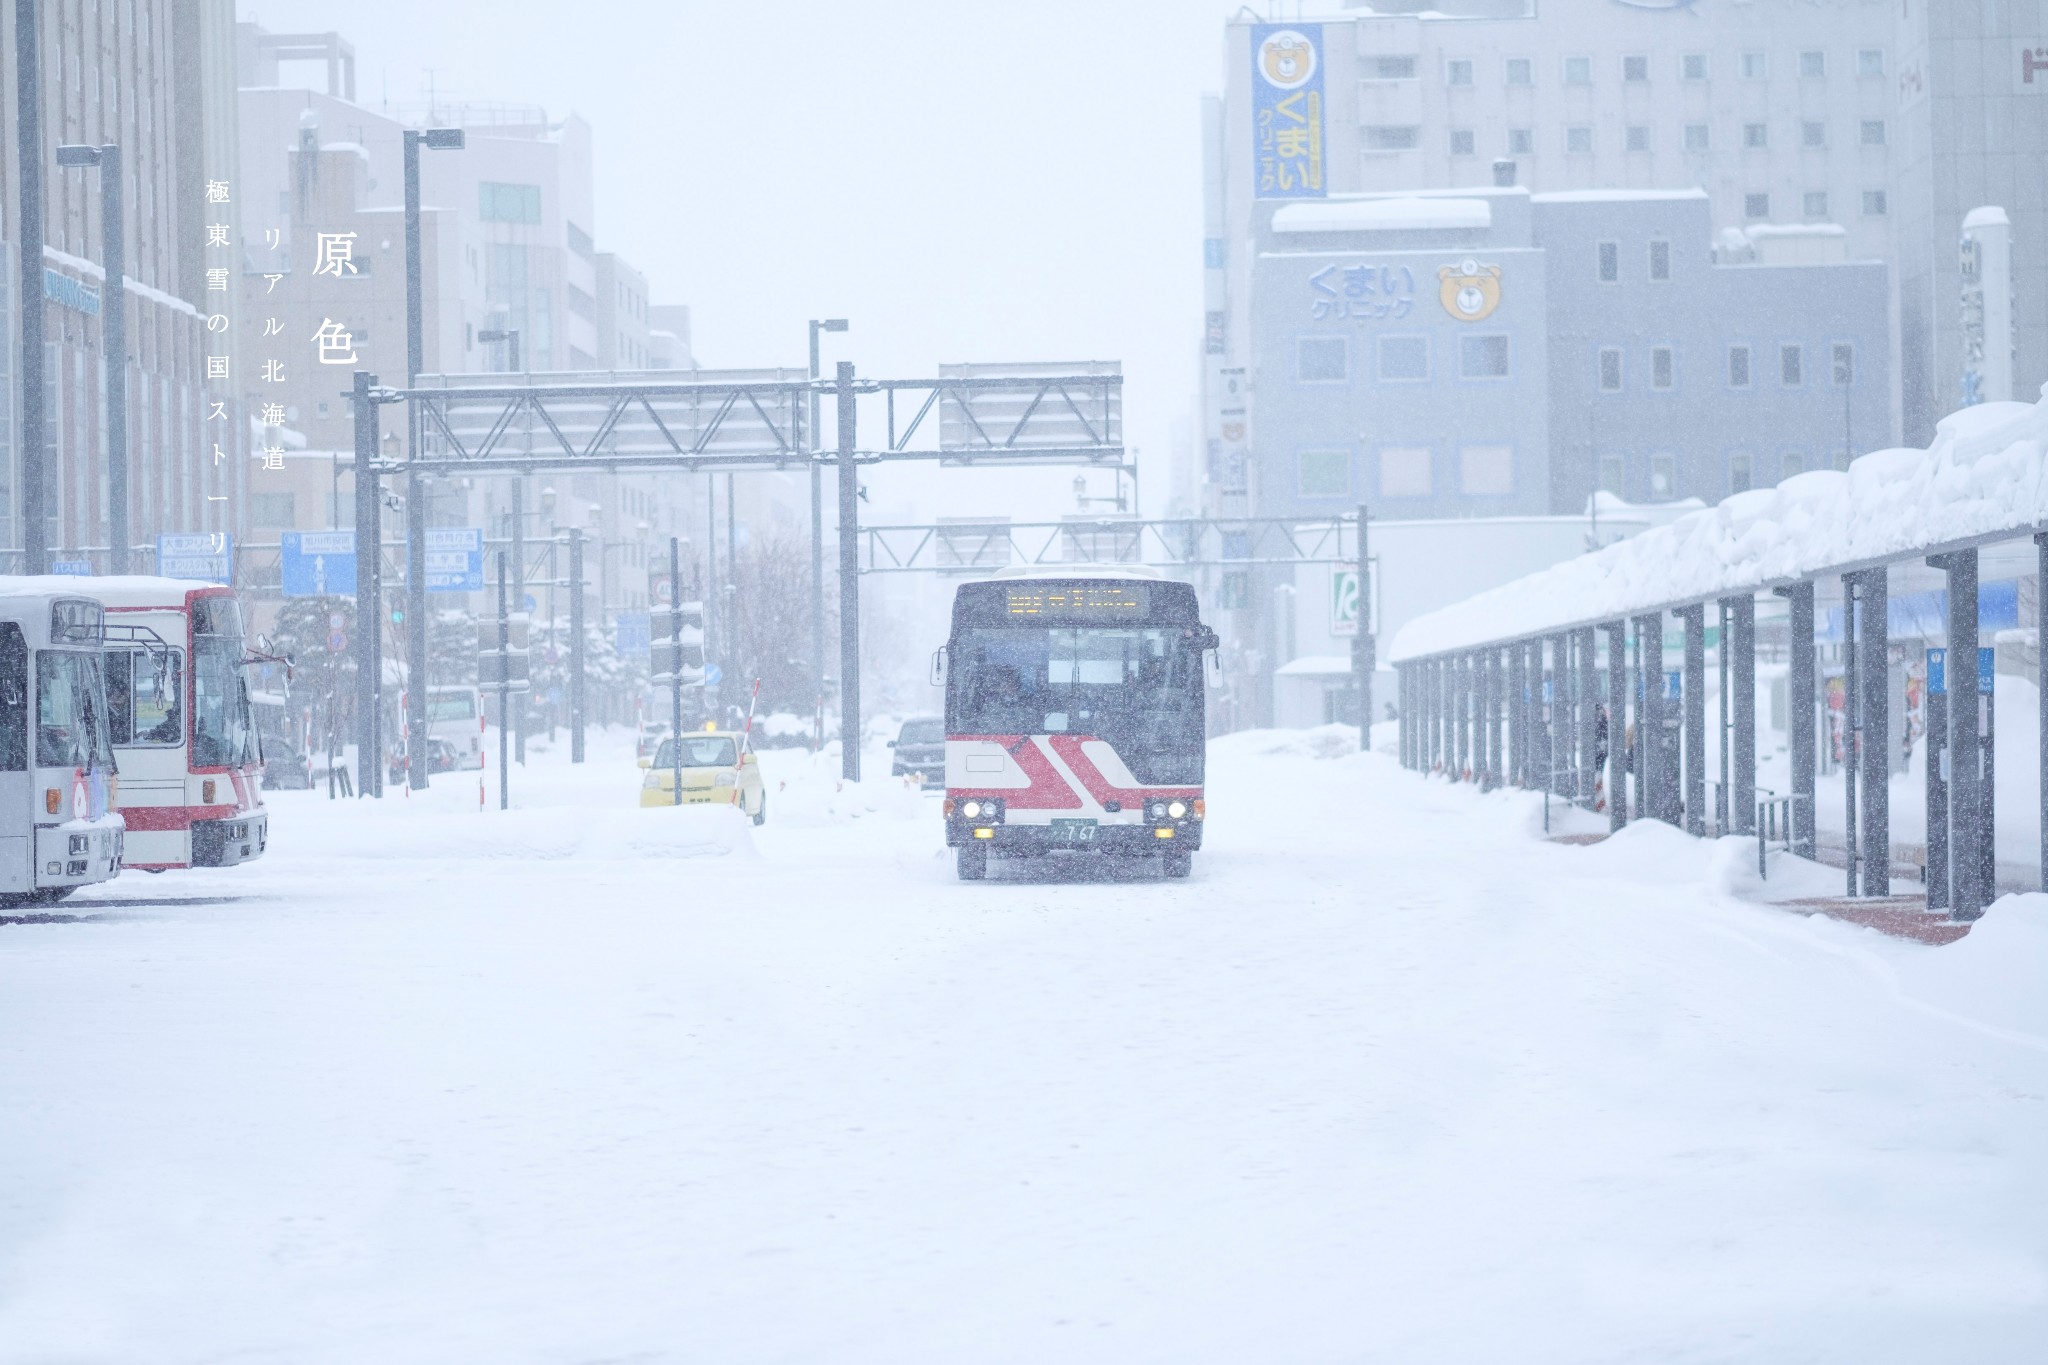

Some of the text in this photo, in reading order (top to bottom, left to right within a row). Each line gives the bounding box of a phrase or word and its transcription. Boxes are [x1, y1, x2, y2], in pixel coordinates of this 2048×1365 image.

[1259, 108, 1275, 192] クリニック
[1275, 90, 1309, 191] くまい
[1308, 262, 1416, 298] くまい
[1310, 297, 1415, 321] クリニック
